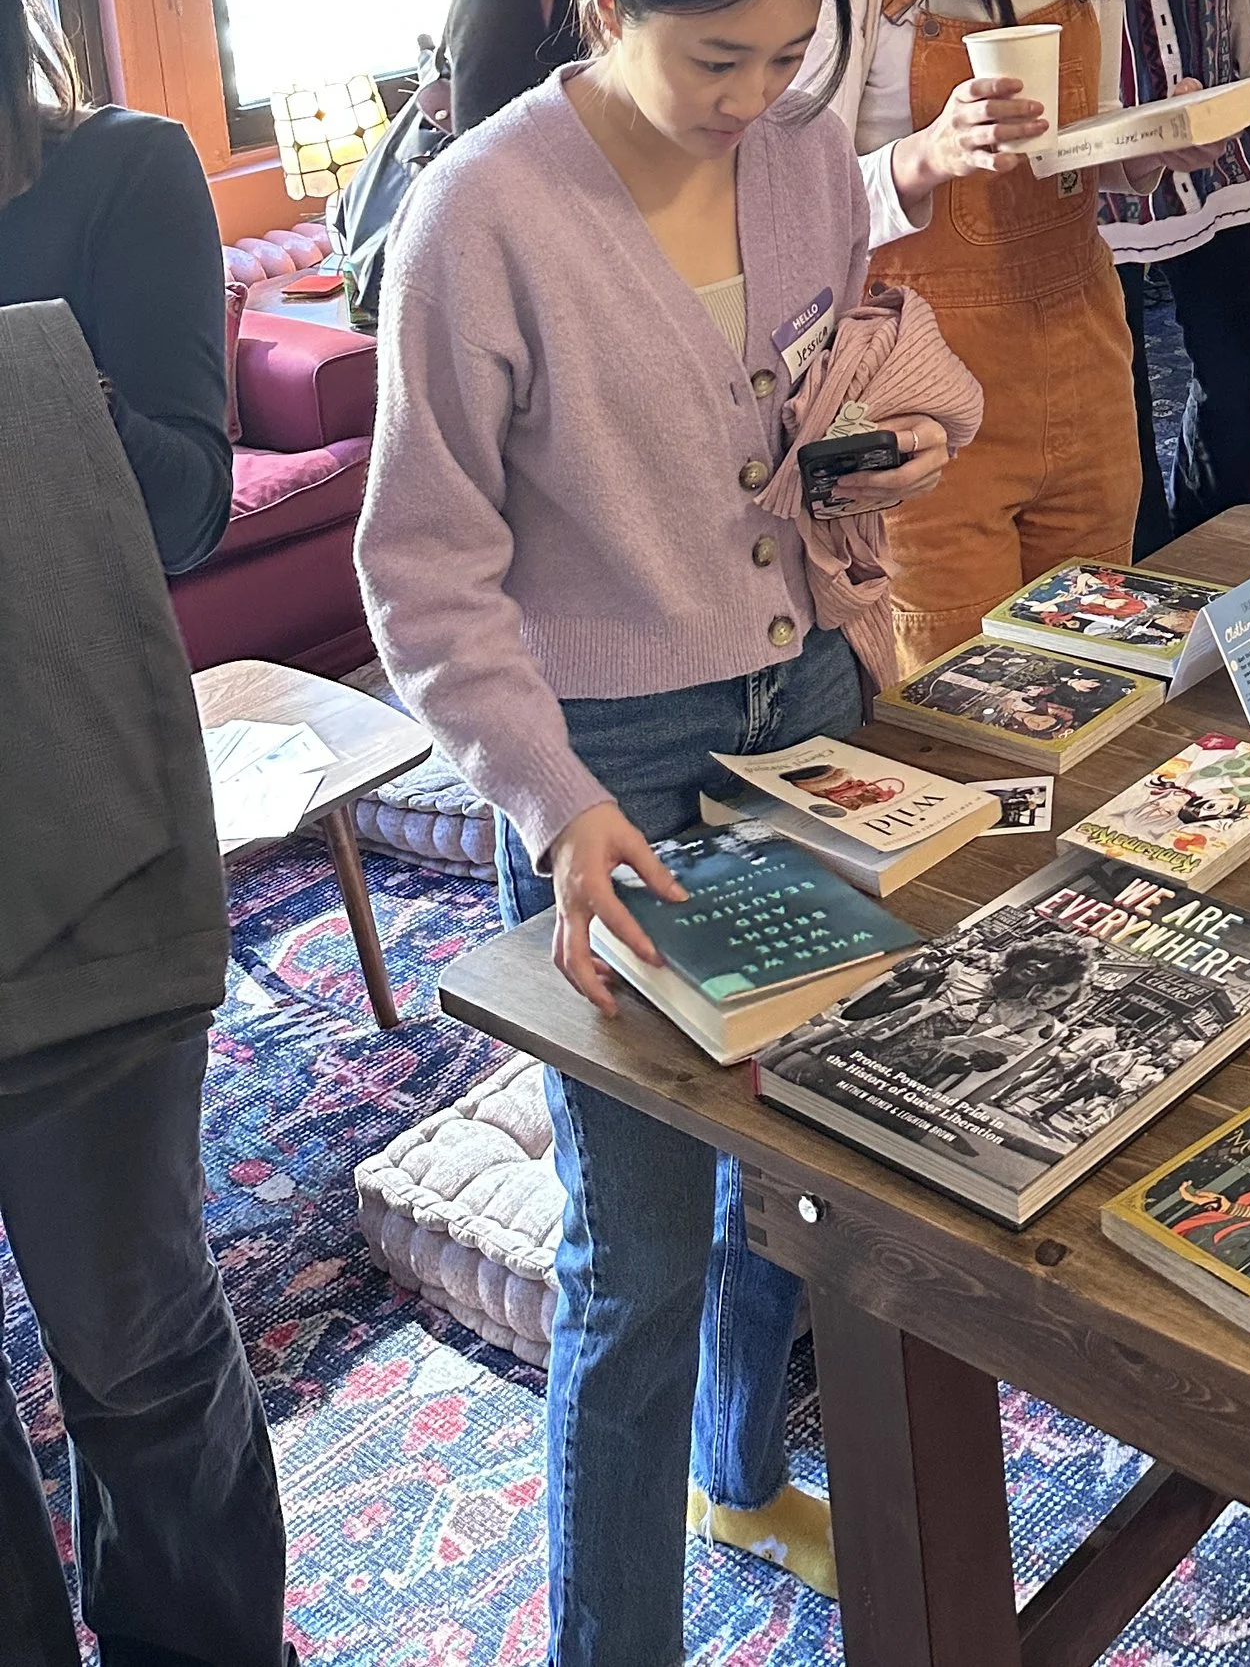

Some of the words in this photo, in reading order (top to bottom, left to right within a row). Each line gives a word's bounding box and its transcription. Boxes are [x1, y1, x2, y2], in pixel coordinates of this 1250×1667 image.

[792, 303, 819, 330] HELLO
[796, 326, 829, 367] Jessica
[862, 793, 948, 836] wild
[675, 881, 815, 926] BEAUTIFUL
[735, 904, 786, 927] AND
[1114, 877, 1176, 917] WE
[1162, 900, 1245, 941] ARE
[728, 909, 827, 946] BRIGHT
[755, 927, 831, 954] WERE
[794, 930, 874, 959] WHEN
[1034, 887, 1250, 984] EVERYWHERE
[742, 957, 785, 973] WE
[826, 1054, 847, 1068] the
[845, 1062, 889, 1091] History
[888, 1084, 907, 1096] of
[902, 1091, 942, 1116] Queer
[939, 1109, 1005, 1145] Liberation
[850, 1050, 892, 1078] Protest,
[893, 1071, 931, 1096] Power,
[931, 1090, 957, 1106] and
[955, 1101, 989, 1122] Pride
[989, 1116, 1005, 1130] in
[836, 1080, 869, 1101] MATTHEW
[866, 1094, 893, 1112] RIEMER
[891, 1107, 900, 1115] &
[897, 1110, 932, 1131] LEIGHTON
[929, 1125, 957, 1143] BROWN
